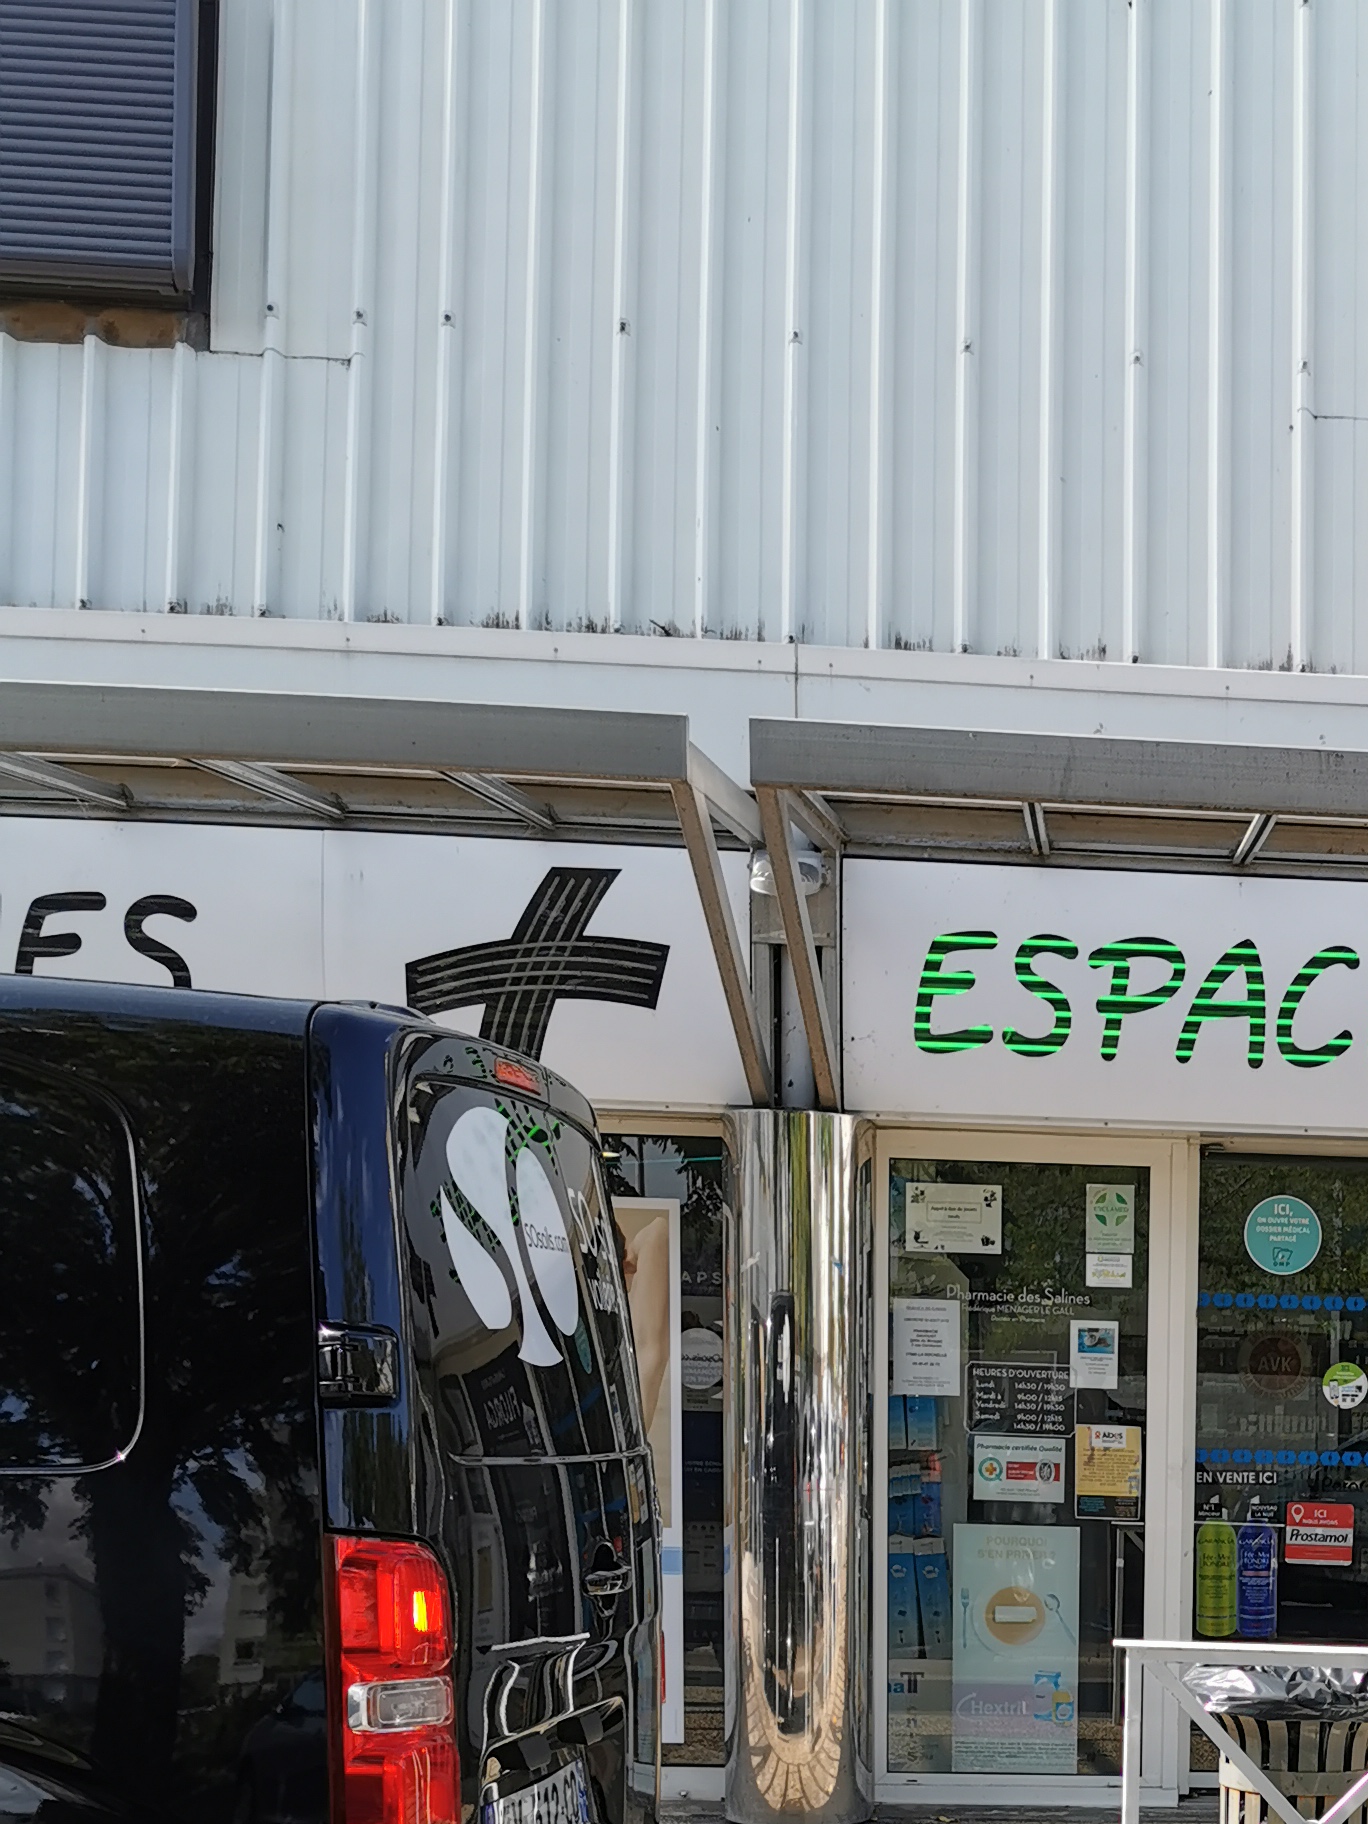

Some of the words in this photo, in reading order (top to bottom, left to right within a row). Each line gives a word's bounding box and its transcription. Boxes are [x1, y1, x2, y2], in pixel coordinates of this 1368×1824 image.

[1273, 1203, 1294, 1216] ICI,
[1289, 1217, 1310, 1225] VOTRE
[1283, 1226, 1310, 1234] MÉDICAL
[946, 1284, 1014, 1303] Pharmacie
[1018, 1287, 1040, 1303] des
[1044, 1288, 1091, 1305] Salines
[1257, 1356, 1292, 1372] AVK
[972, 1368, 1007, 1377] HEURES
[1009, 1369, 1069, 1380] D'OUVERTURE
[975, 1380, 995, 1388] Lundi
[975, 1391, 996, 1399] Mardi
[976, 1443, 1010, 1451] Pharmacie
[1011, 1443, 1038, 1451] certifiée
[1039, 1444, 1063, 1453] Qualité
[1196, 1471, 1213, 1483] EN
[1216, 1472, 1256, 1484] VENTE
[1259, 1472, 1277, 1484] ICI
[1314, 1509, 1327, 1518] ICI
[1289, 1528, 1349, 1543] Prostamol
[986, 1536, 1048, 1547] POURQUOI
[977, 1549, 1003, 1559] S'EN
[971, 1700, 1027, 1716] Hextril
